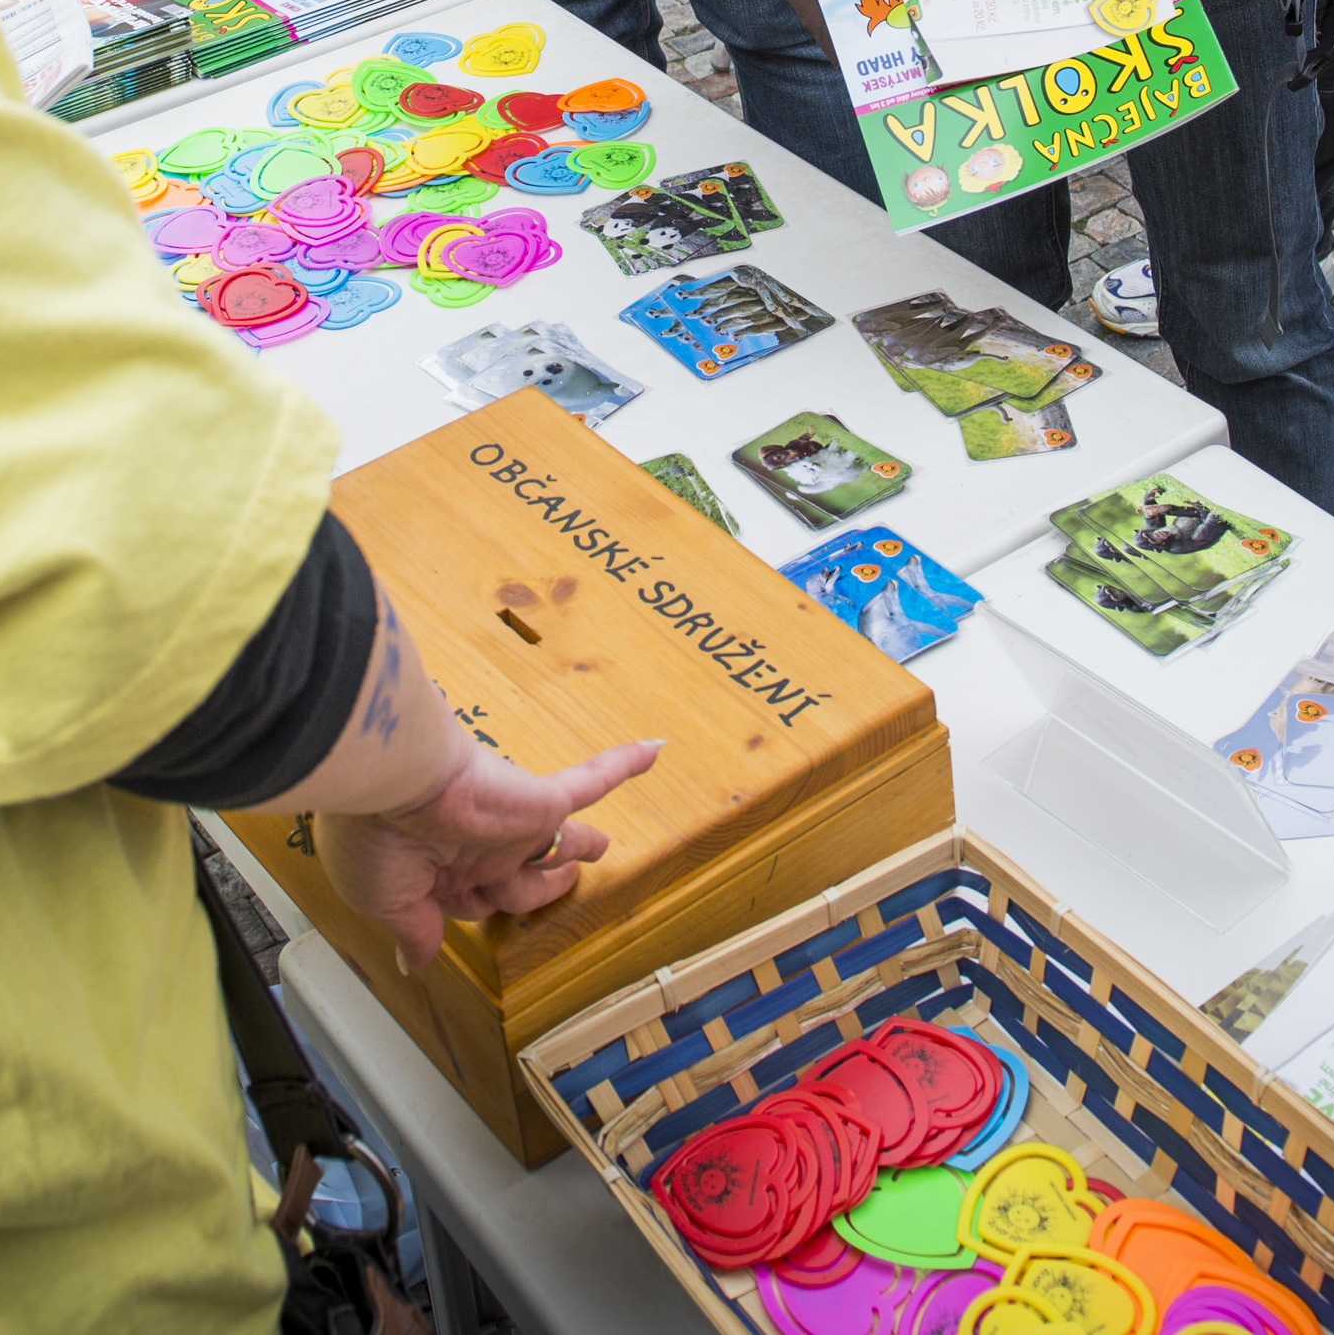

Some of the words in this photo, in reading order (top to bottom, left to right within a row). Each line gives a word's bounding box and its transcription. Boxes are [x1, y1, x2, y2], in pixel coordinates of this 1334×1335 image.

[973, 8, 984, 19] 20
[985, 0, 996, 11] 30
[975, 20, 985, 31] Kč
[986, 11, 997, 23] Kč
[855, 50, 905, 77] HRAD
[861, 66, 923, 94] MATÝSEK
[886, 8, 1198, 163] ŠKOLKA
[885, 97, 895, 105] od
[1033, 64, 1213, 172] BÁJEČNÁ
[469, 443, 665, 582] OBČANSKÉ
[637, 580, 833, 728] SDRUŽENÍ
